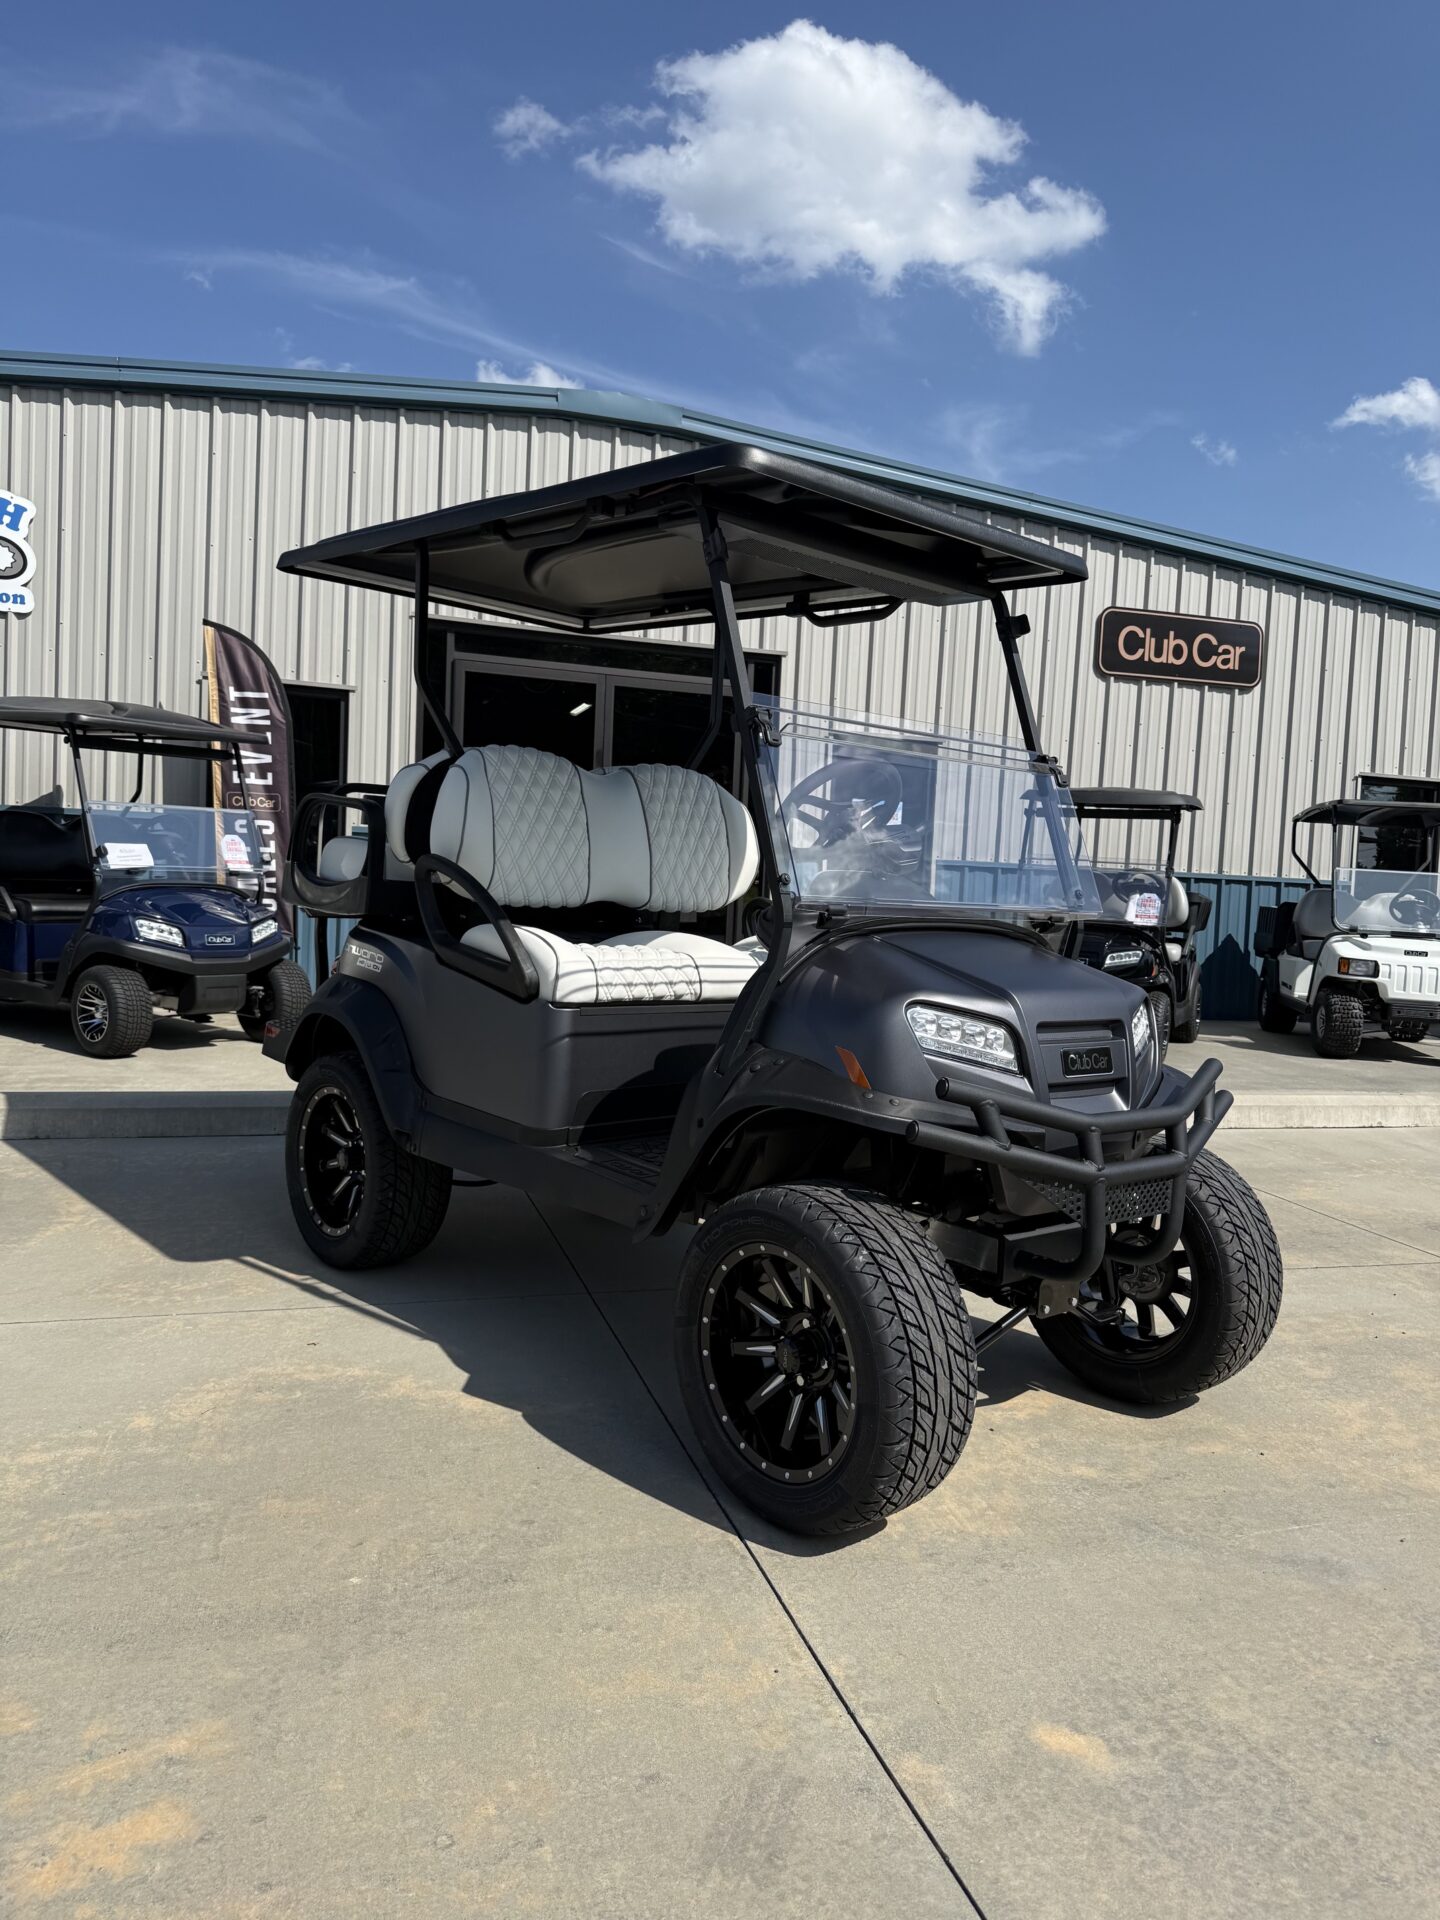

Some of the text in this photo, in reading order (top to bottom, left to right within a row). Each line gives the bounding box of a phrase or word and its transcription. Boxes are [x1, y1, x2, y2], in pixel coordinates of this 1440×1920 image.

[1117, 625, 1246, 671] Club Car
[229, 686, 273, 785] EVNT
[232, 796, 275, 808] Clb Car
[1068, 1053, 1108, 1070] Club Car
